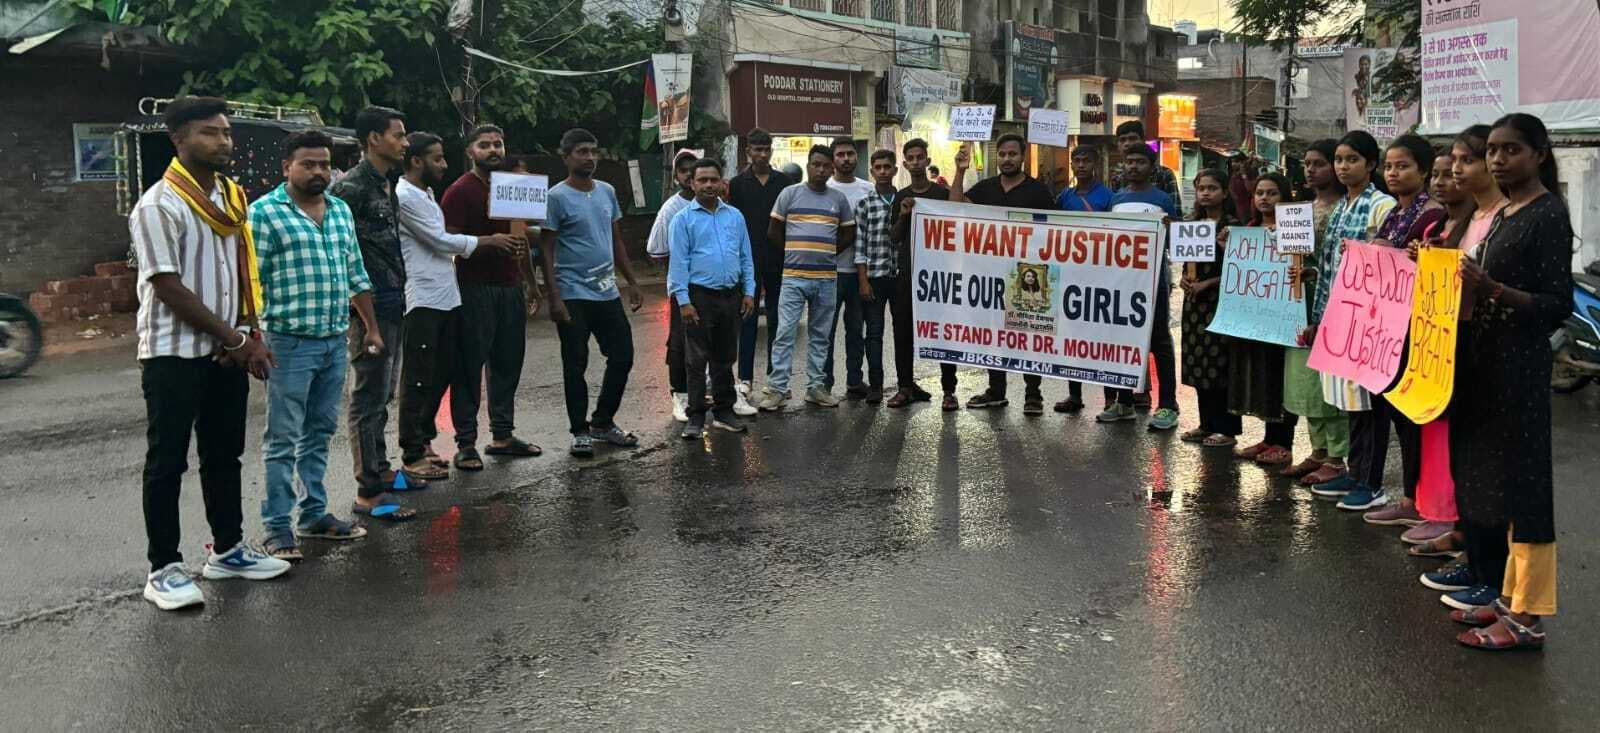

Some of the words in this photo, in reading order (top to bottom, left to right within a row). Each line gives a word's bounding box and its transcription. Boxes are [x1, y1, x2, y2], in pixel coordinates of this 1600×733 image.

[1438, 39, 1446, 52] 10
[1472, 32, 1488, 46] तक
[764, 74, 796, 90] PODDAR
[800, 78, 844, 94] STATIONERY
[966, 116, 979, 126] करो
[987, 108, 992, 116] 4
[1378, 116, 1392, 126] साल
[496, 184, 513, 201] SAVE
[514, 186, 528, 202] OUR
[528, 188, 546, 203] GIRLS
[1178, 224, 1211, 238] NO
[1279, 220, 1312, 228] VIOLENCE
[924, 218, 956, 252] WE
[964, 222, 1034, 258] WANT
[1038, 228, 1149, 270] JUSTICE
[1176, 244, 1214, 257] RAPE
[1227, 234, 1258, 260] WOH
[1342, 248, 1373, 295] We
[916, 269, 962, 306] SAVE
[968, 274, 1006, 311] OUR
[1062, 284, 1147, 328] GIRLS
[916, 320, 939, 339] WE
[944, 324, 992, 346] STAND
[997, 330, 1028, 350] FOR
[1033, 334, 1058, 355] DR.
[1064, 338, 1142, 366] MOUMITA
[958, 352, 1003, 366] JBKSS
[1006, 356, 1011, 368] /
[1014, 360, 1052, 374] JLKM
